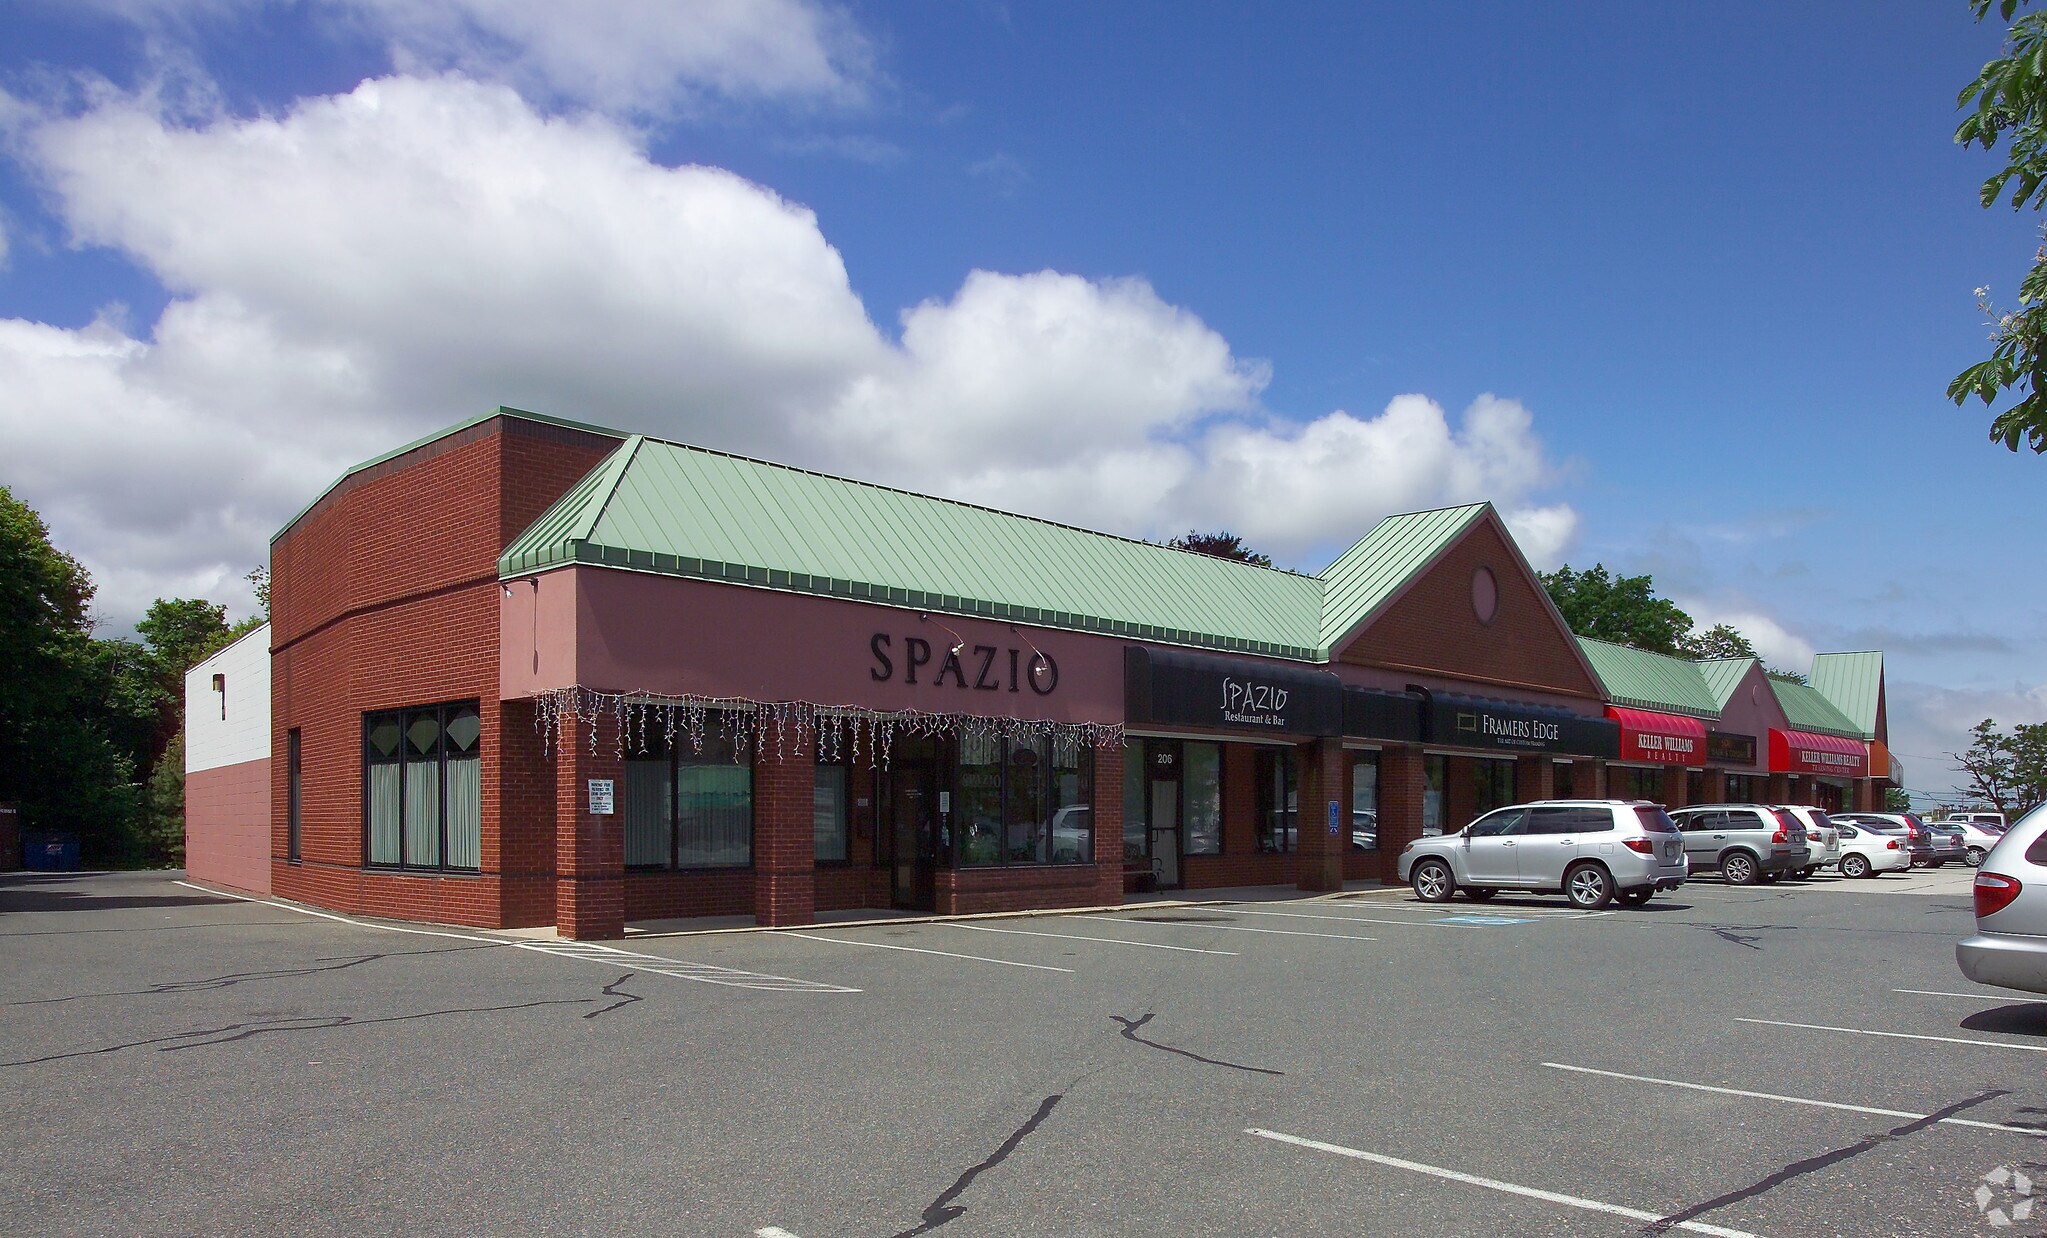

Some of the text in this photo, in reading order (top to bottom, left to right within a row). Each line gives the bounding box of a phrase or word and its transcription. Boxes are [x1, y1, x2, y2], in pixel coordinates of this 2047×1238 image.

[871, 633, 1059, 696] SPAZIO
[1220, 677, 1289, 714] SPAZIO
[1225, 711, 1285, 726] Restaurant & Bar
[1483, 714, 1559, 740] FRAMERS EDGE
[1638, 733, 1662, 750] KELLER
[1664, 736, 1694, 753] WILLIAMS
[1157, 753, 1173, 764] 206
[1647, 750, 1685, 762] REALTY
[1801, 750, 1860, 767] KELLER WILLIAMS REALTY
